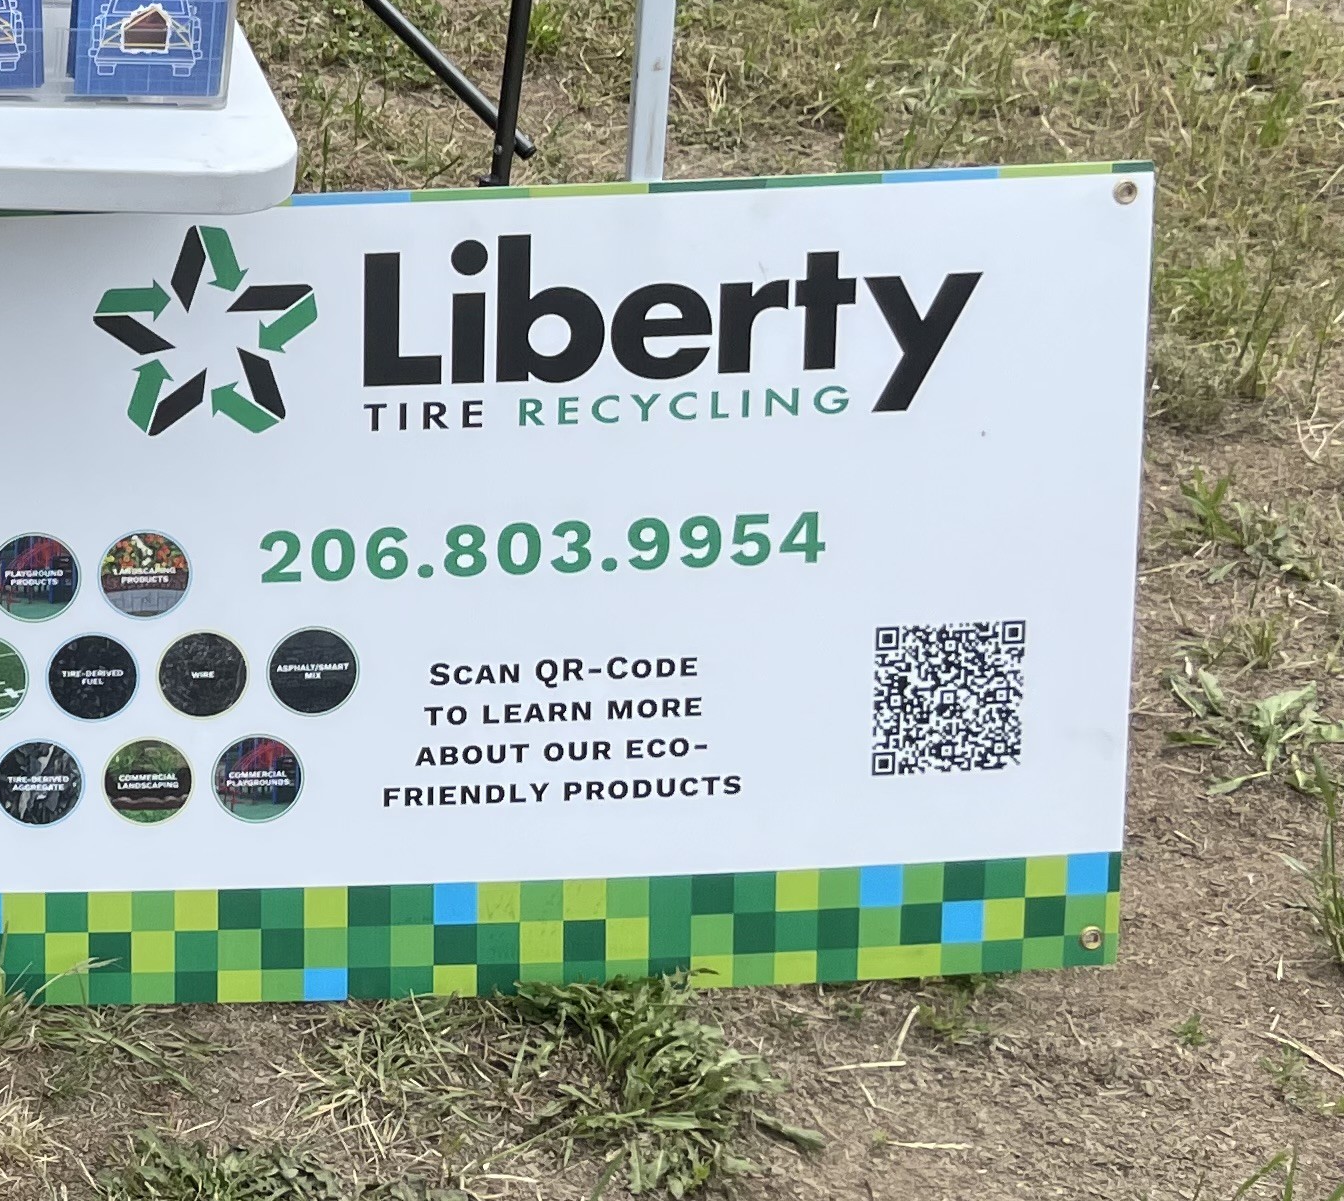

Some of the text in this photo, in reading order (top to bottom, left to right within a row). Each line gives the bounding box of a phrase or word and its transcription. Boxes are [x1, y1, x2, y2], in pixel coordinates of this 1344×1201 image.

[363, 234, 984, 413] Liberty
[363, 386, 850, 432] TIRE RECYCLING
[259, 510, 827, 584] 206.803.9954
[4, 569, 64, 578] PLAYGROUND
[10, 578, 59, 587] PRODUCTS
[120, 575, 170, 585] PRODUCTS
[276, 662, 350, 673] ASPHALT/SMART
[429, 656, 698, 688] SCAN QR-CODE
[61, 669, 124, 679] TIRE-DERIVED
[191, 670, 215, 679] WIRE
[304, 672, 322, 680] MIX
[81, 677, 104, 686] FUEL
[424, 696, 703, 726] TO LEARN MORE
[415, 737, 709, 767] ABOUT OUR ECO-
[7, 775, 70, 785] TIRE-DERIVED
[118, 773, 179, 783] COMMERCIAL
[228, 770, 288, 780] COMMERCIAL
[12, 782, 65, 792] AGGREGATE
[116, 780, 180, 791] LANDSCAPING
[226, 778, 290, 788] PLAYGROUNDS
[382, 775, 742, 808] FRIENDLY PRODUCTS
